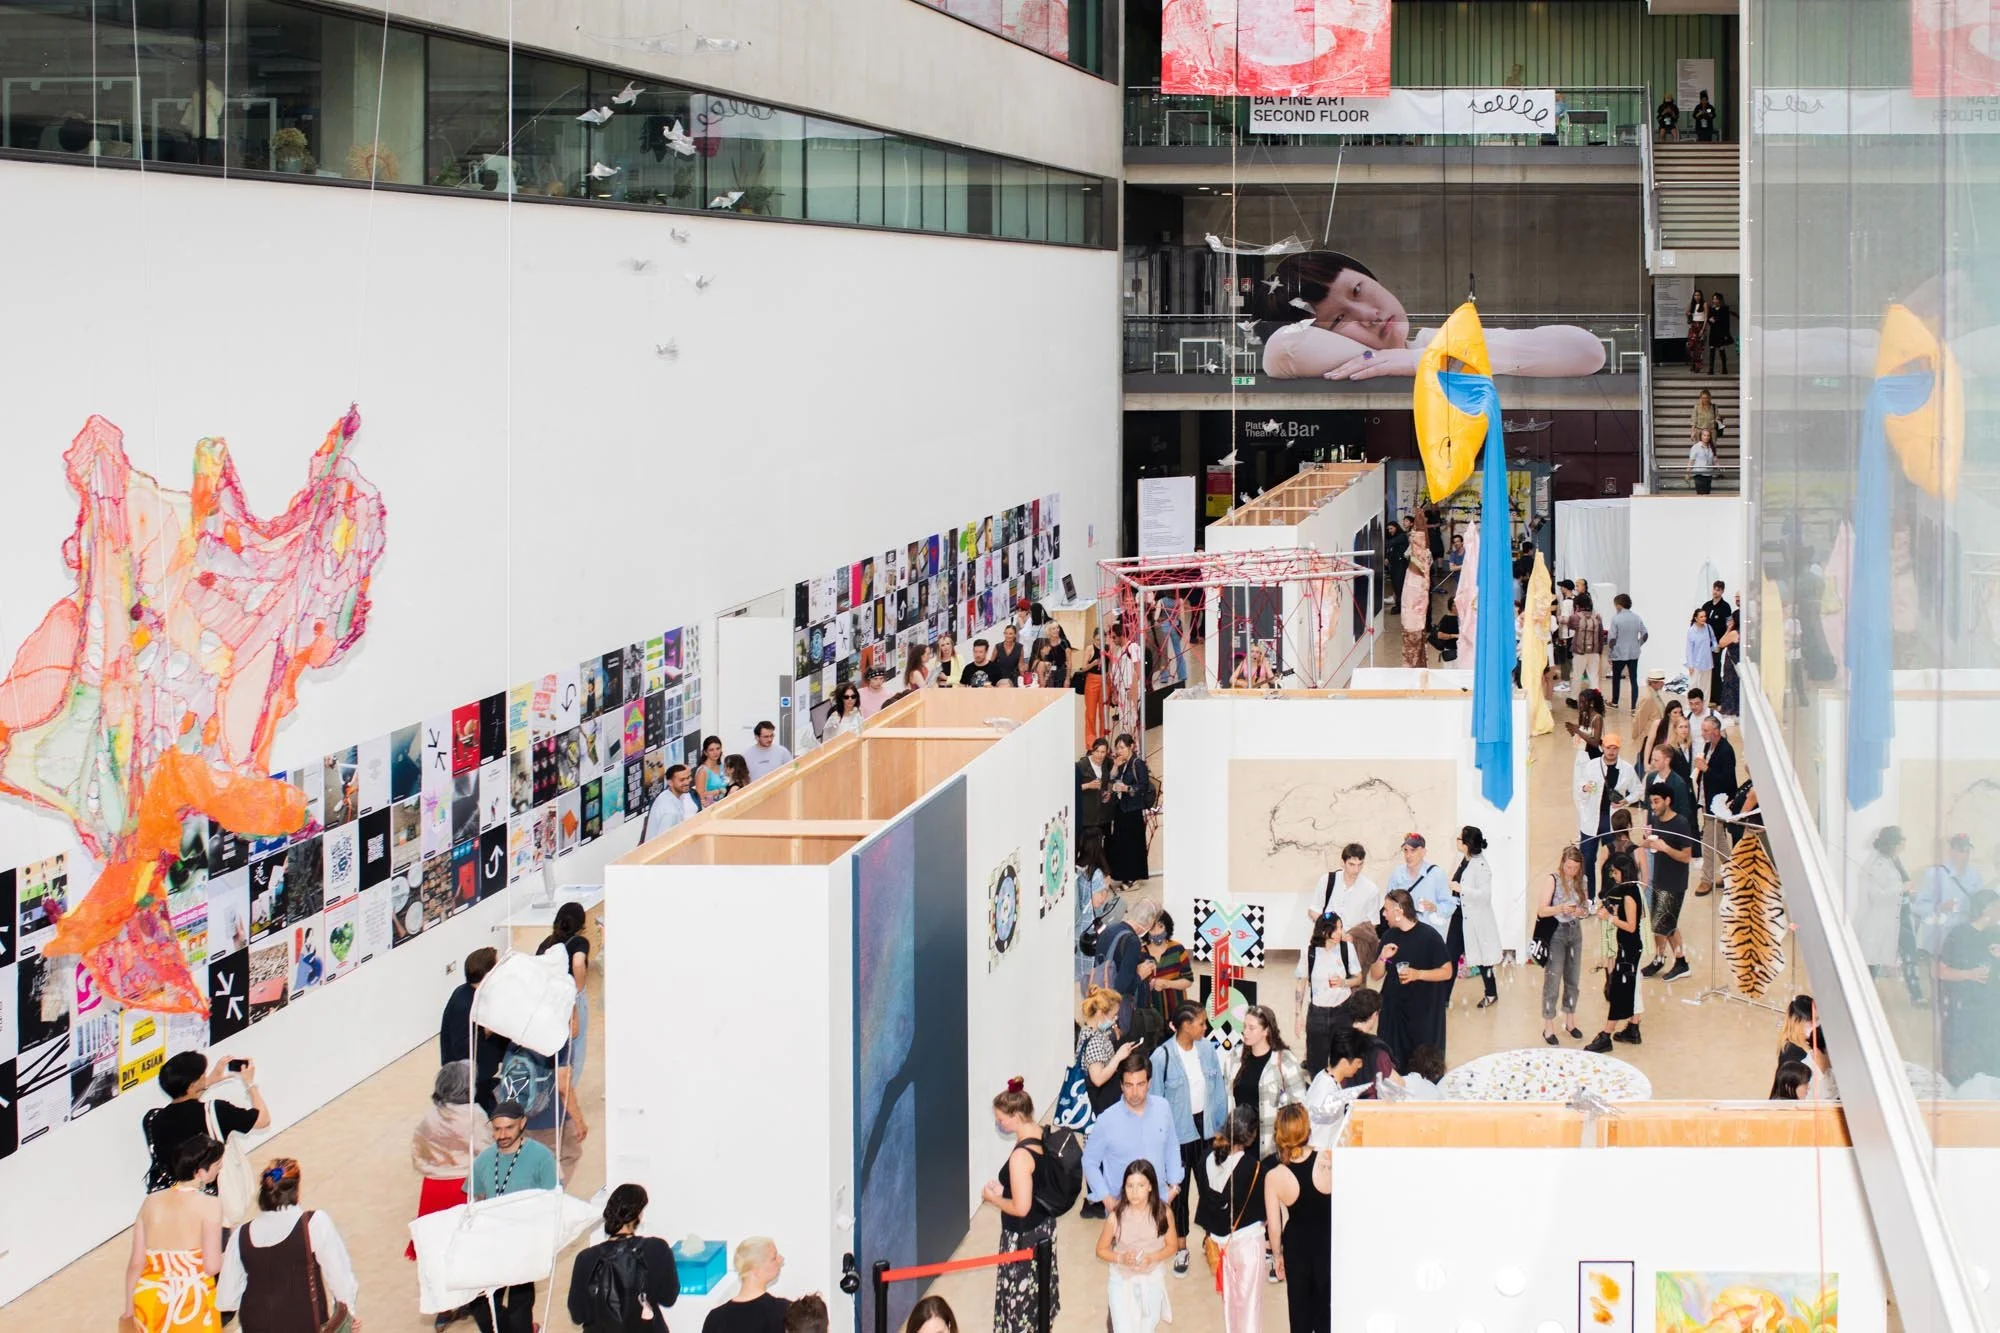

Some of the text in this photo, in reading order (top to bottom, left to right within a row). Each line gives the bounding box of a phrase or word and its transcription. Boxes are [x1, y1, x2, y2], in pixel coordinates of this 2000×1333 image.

[1254, 96, 1345, 106] BA FINE ART
[1254, 109, 1369, 122] SECOND FLOOR
[1288, 421, 1320, 437] Bar
[122, 1053, 163, 1082] DIY ASIAN
